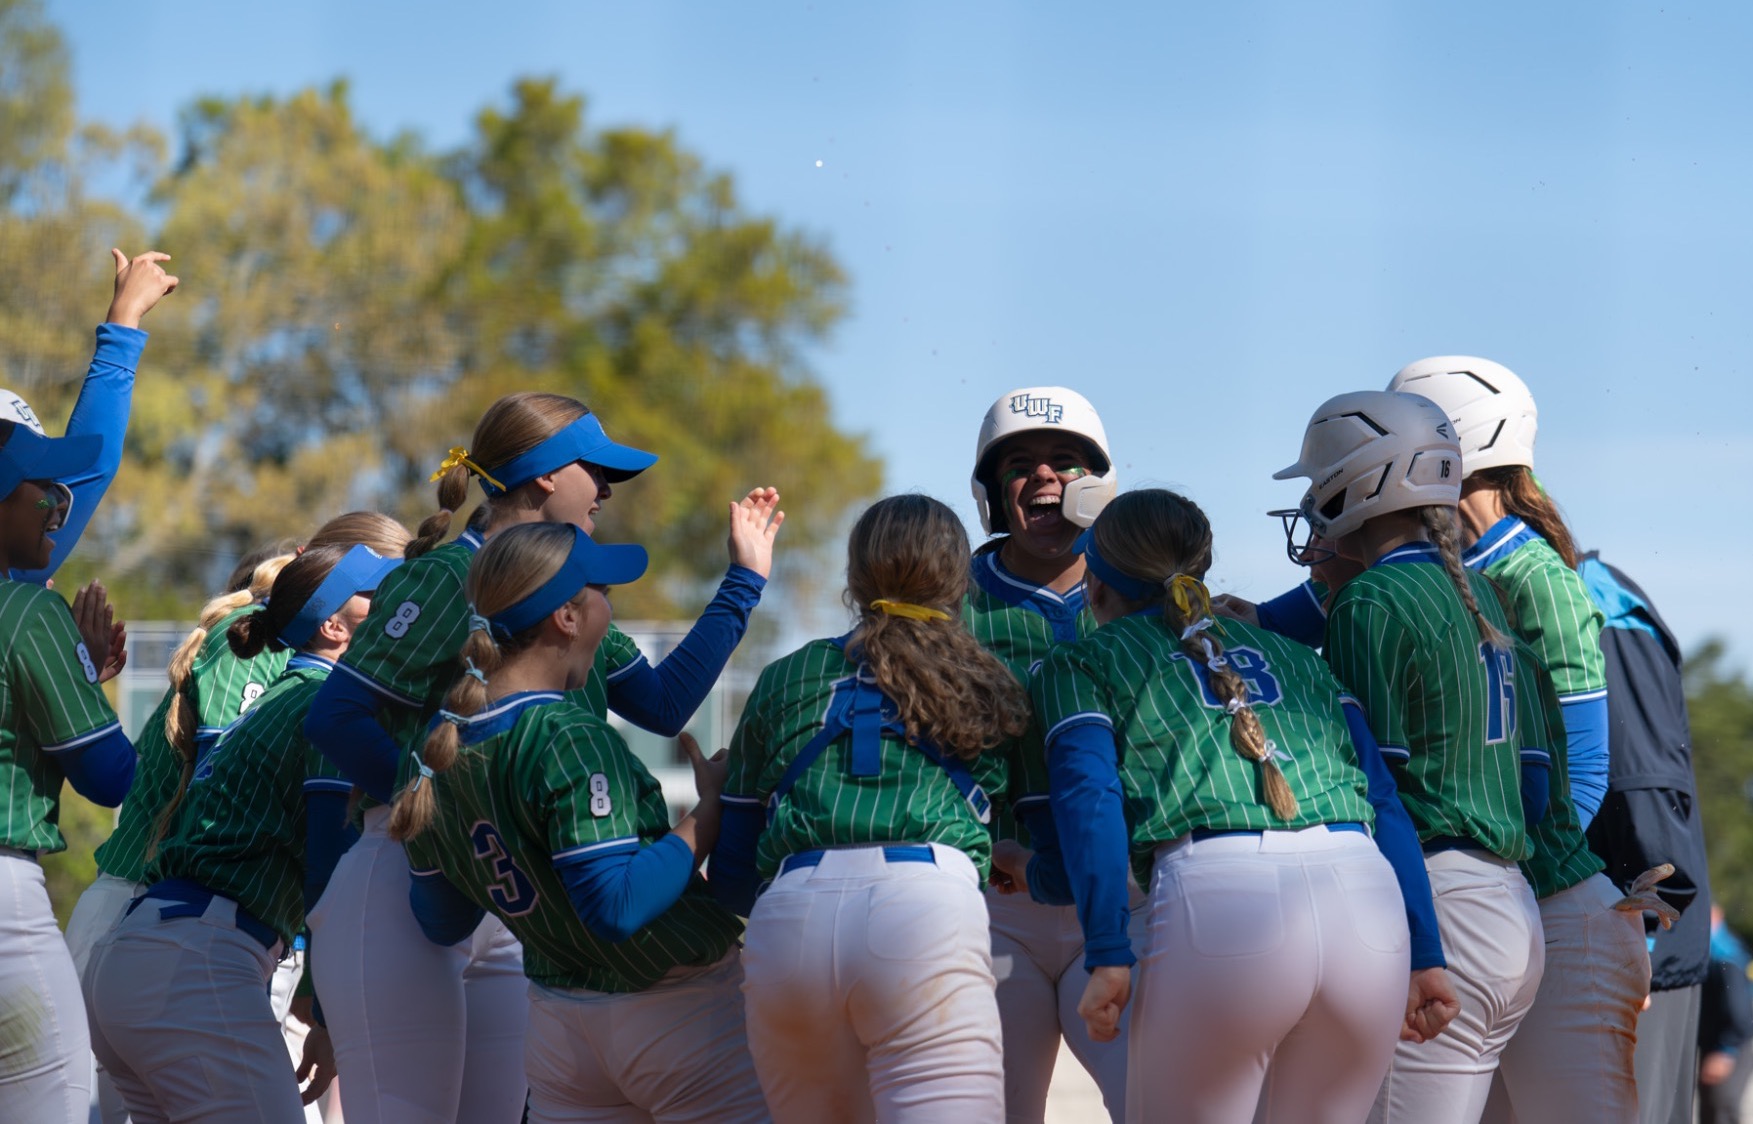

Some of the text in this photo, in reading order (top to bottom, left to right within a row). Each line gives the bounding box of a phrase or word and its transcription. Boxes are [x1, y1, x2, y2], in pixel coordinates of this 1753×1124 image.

[1009, 393, 1063, 424] UWF
[1318, 468, 1344, 490] EASTON
[1440, 459, 1451, 478] 16
[384, 600, 421, 640] 8
[76, 641, 98, 684] 8
[589, 772, 612, 817] 8
[470, 819, 540, 917] 3
